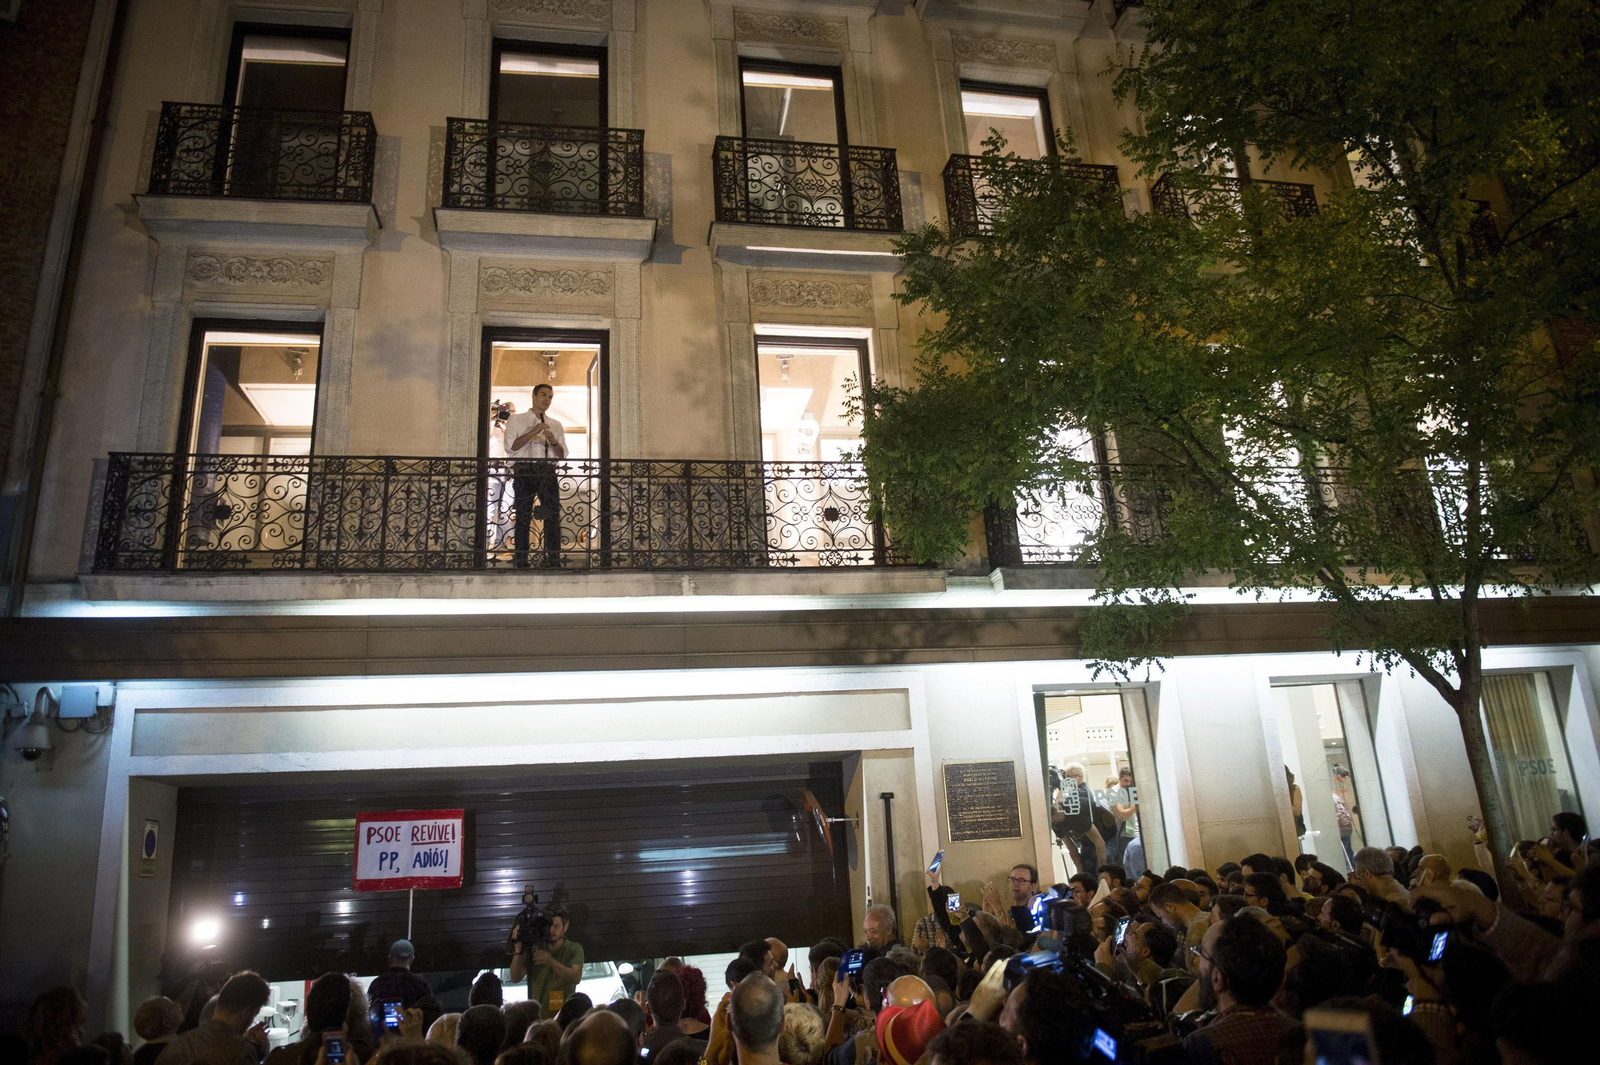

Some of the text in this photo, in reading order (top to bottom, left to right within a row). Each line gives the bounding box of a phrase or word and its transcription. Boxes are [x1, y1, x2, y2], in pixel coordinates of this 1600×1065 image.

[1518, 758, 1557, 776] PSOE
[1094, 786, 1140, 808] PSOE
[366, 821, 456, 846] PSOE REVIVE!
[379, 848, 449, 874] PP, ADIÓS!
